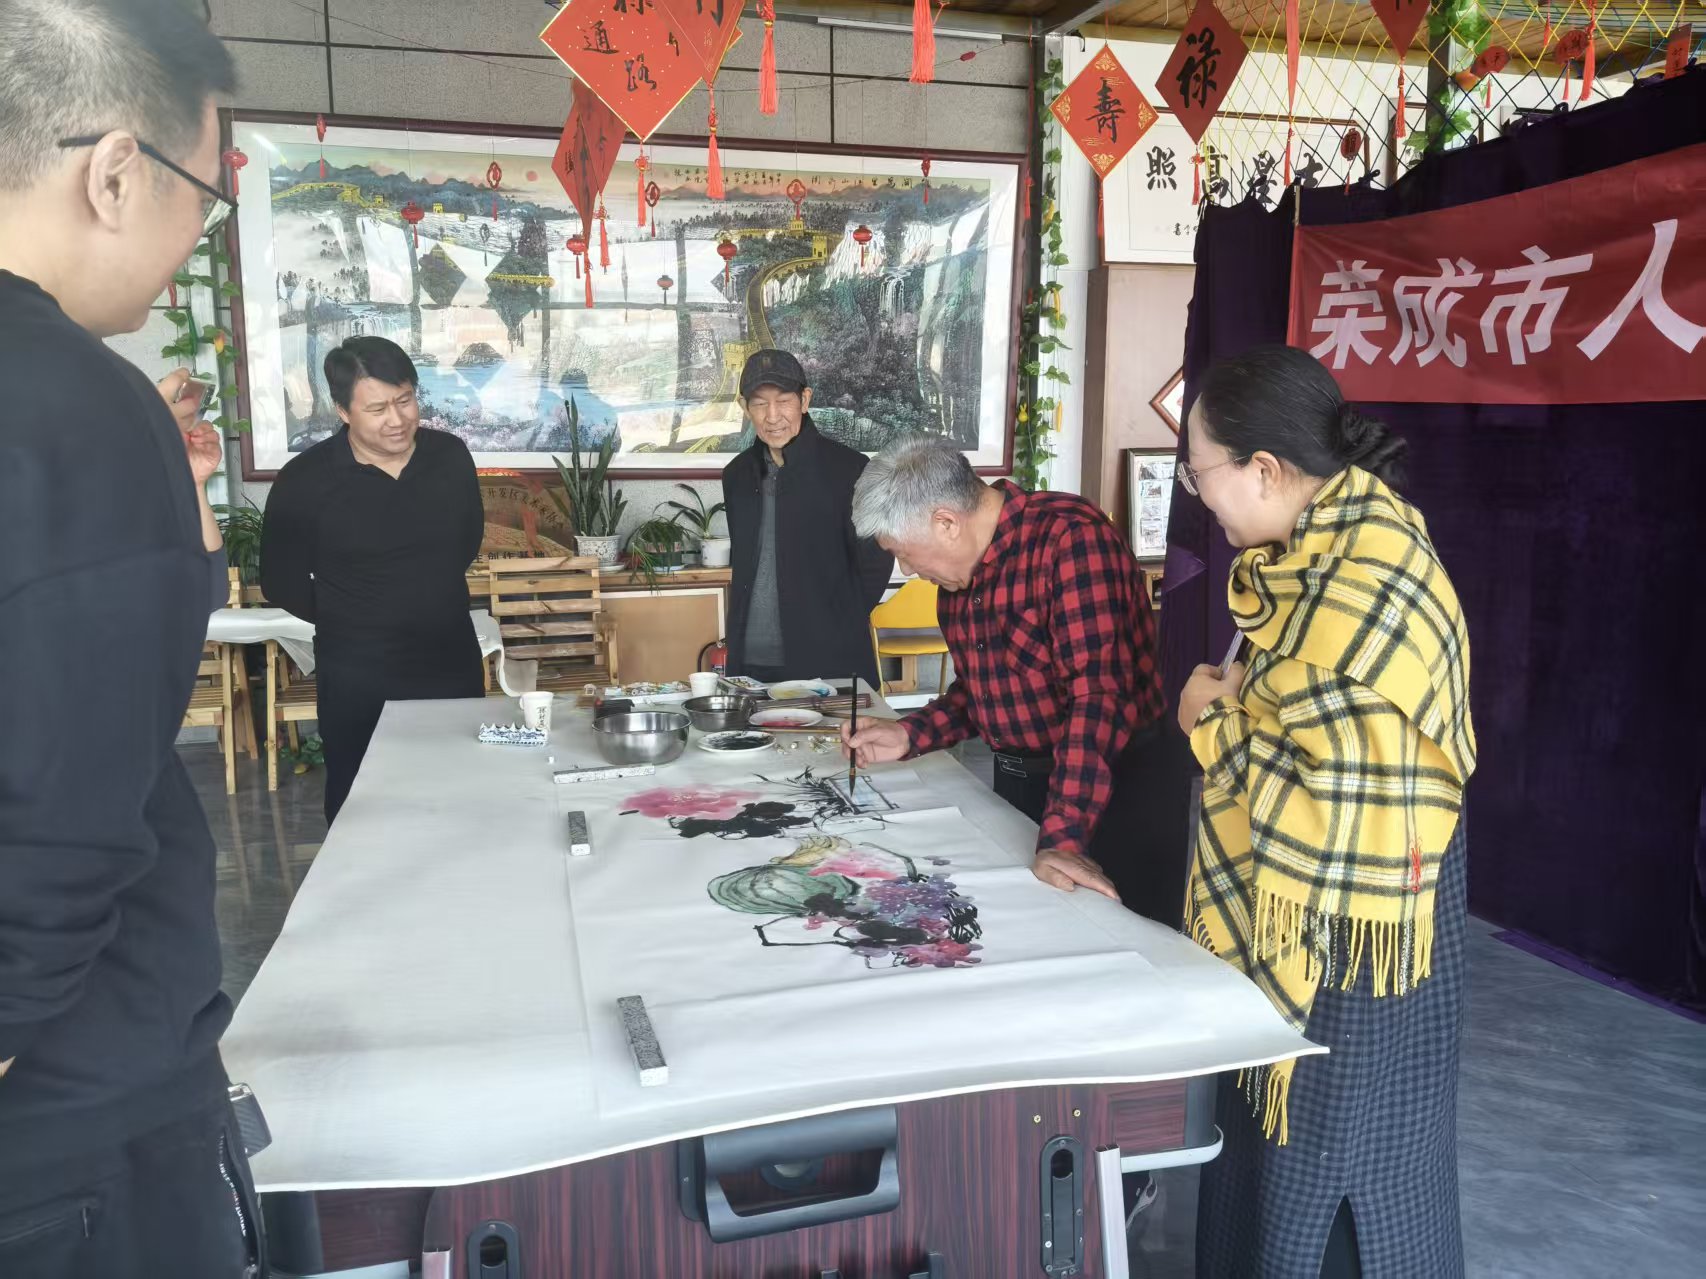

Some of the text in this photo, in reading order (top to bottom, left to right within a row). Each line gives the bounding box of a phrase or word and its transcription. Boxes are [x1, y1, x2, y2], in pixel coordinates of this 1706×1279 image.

[1176, 27, 1222, 109] 禄
[1309, 219, 1706, 370] 荣成市人
